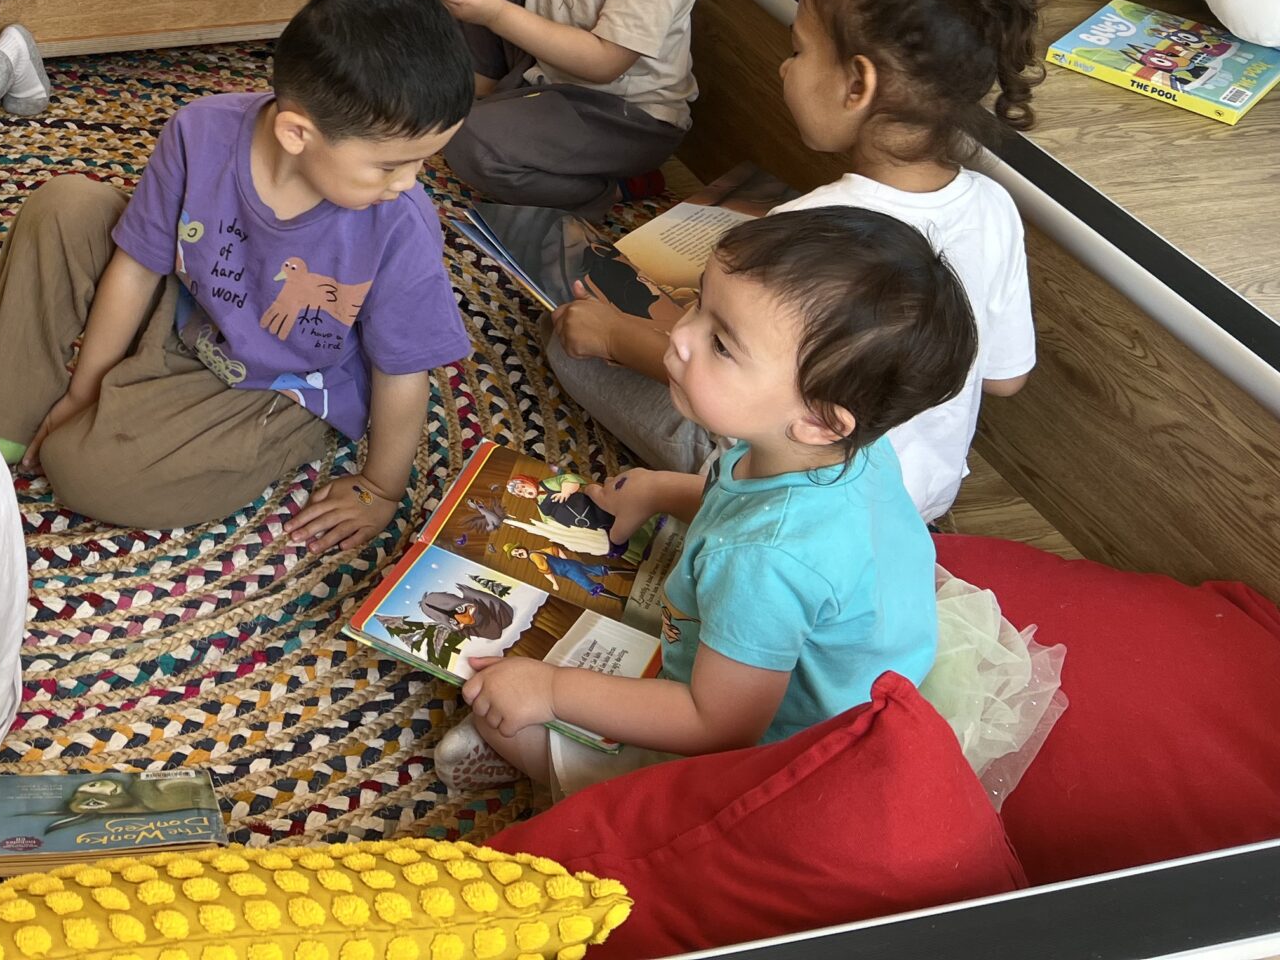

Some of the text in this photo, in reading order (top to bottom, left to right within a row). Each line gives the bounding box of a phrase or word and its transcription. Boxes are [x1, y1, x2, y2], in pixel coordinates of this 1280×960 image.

[1130, 79, 1178, 102] THE POOL
[227, 218, 248, 242] day
[220, 243, 234, 260] of
[211, 262, 245, 282] hard
[211, 286, 248, 308] word
[310, 328, 333, 340] have
[314, 342, 342, 350] bird
[105, 817, 209, 832] Donkey
[77, 827, 213, 845] The Wonky
